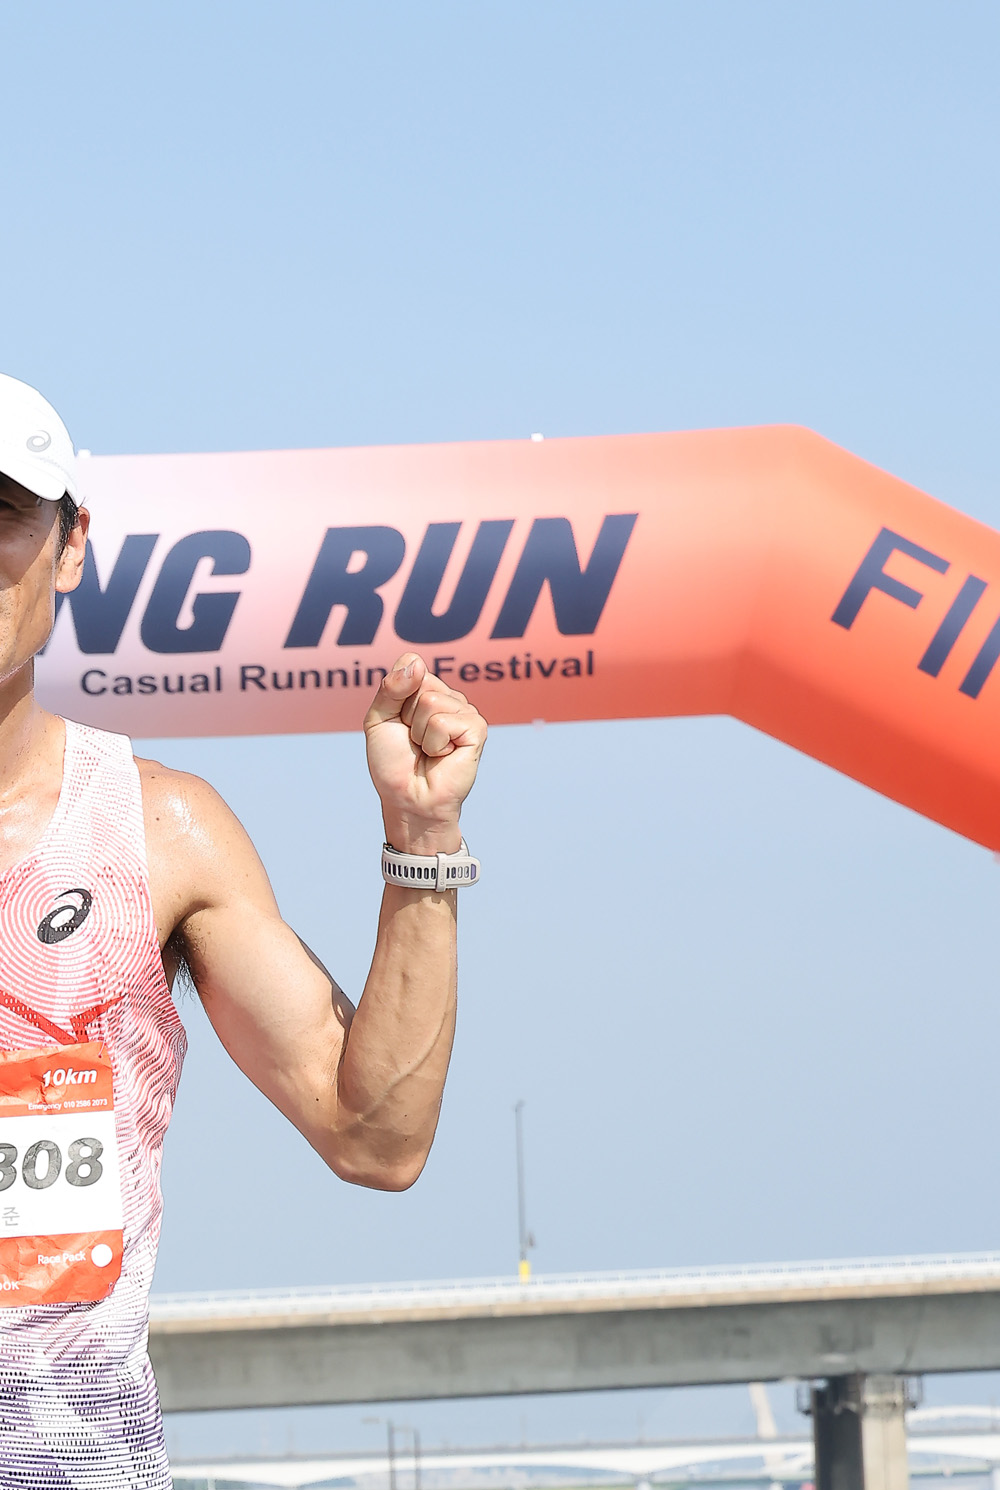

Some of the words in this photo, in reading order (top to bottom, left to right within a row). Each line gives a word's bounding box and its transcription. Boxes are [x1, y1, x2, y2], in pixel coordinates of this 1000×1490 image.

[284, 513, 638, 649] RUN
[81, 666, 222, 697] Casual
[240, 661, 387, 691] Runnin
[433, 650, 595, 682] Festival
[42, 1068, 98, 1088] 10km
[37, 1253, 61, 1265] Race
[62, 1250, 87, 1263] Pack
